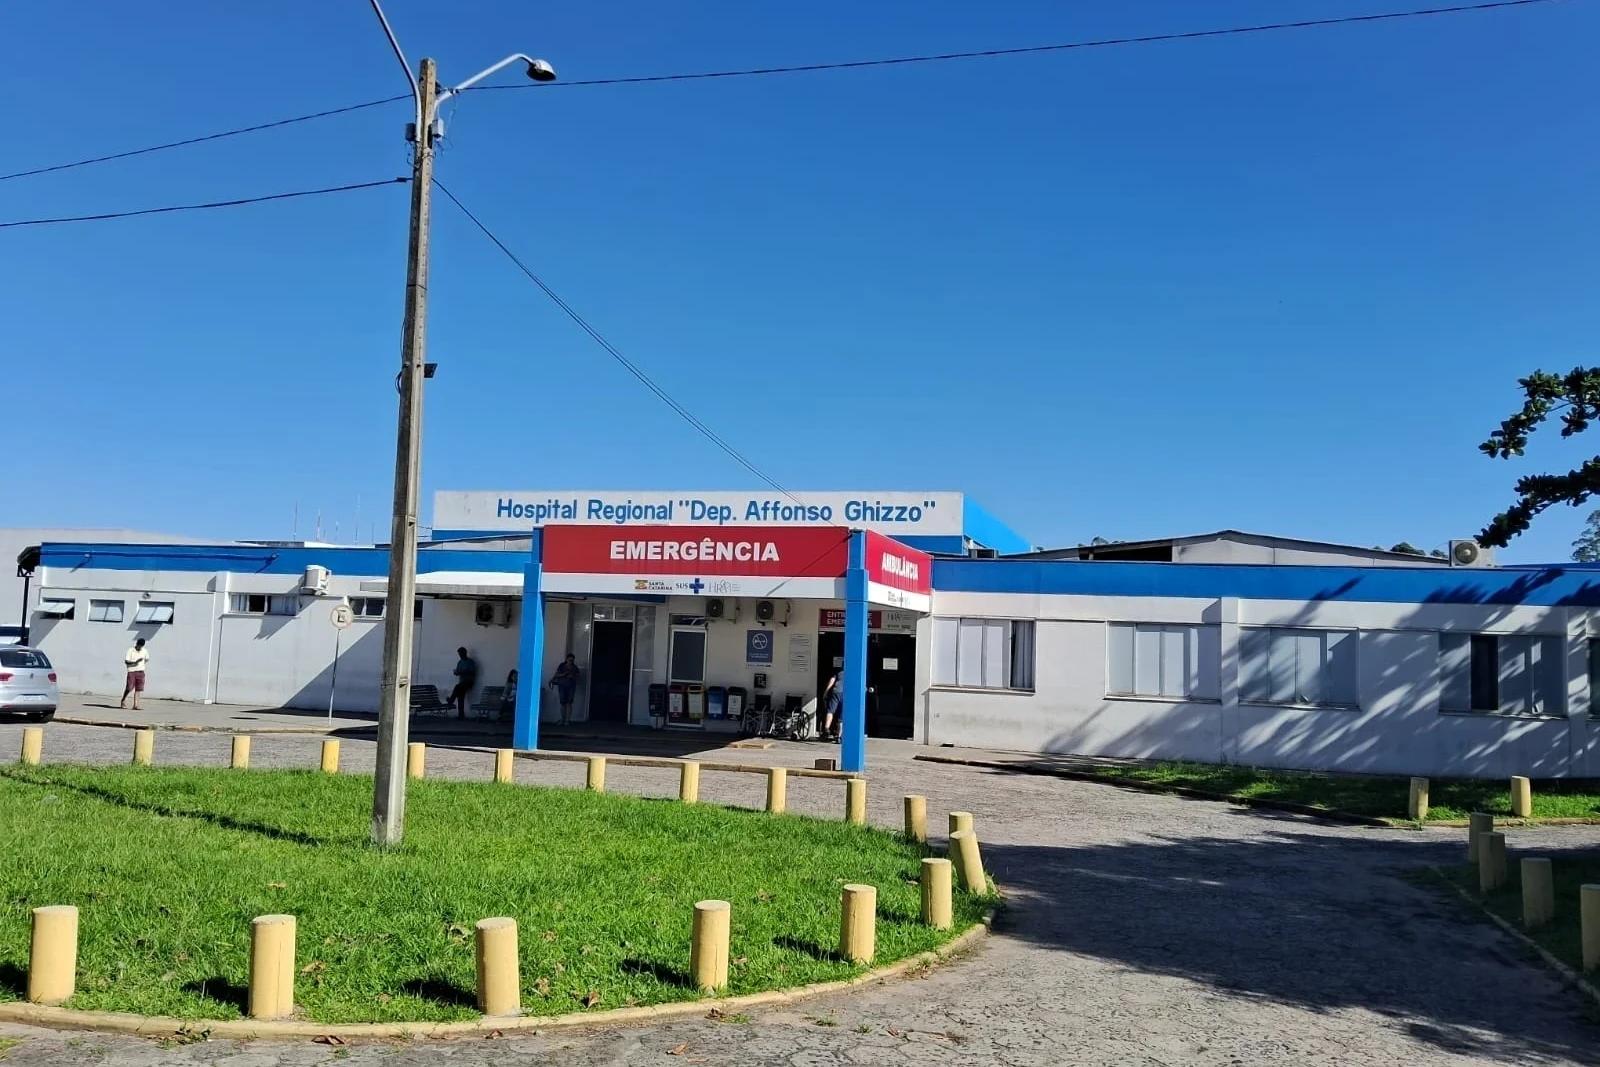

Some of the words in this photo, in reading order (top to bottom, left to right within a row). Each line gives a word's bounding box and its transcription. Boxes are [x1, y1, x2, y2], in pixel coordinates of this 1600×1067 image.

[497, 498, 577, 523] Hospital
[587, 499, 673, 524] Regional
[679, 500, 736, 524] "Dep.
[745, 501, 833, 521] Affonso
[845, 500, 935, 522] Ghizzo"
[610, 537, 780, 562] EMERGÊNCIA
